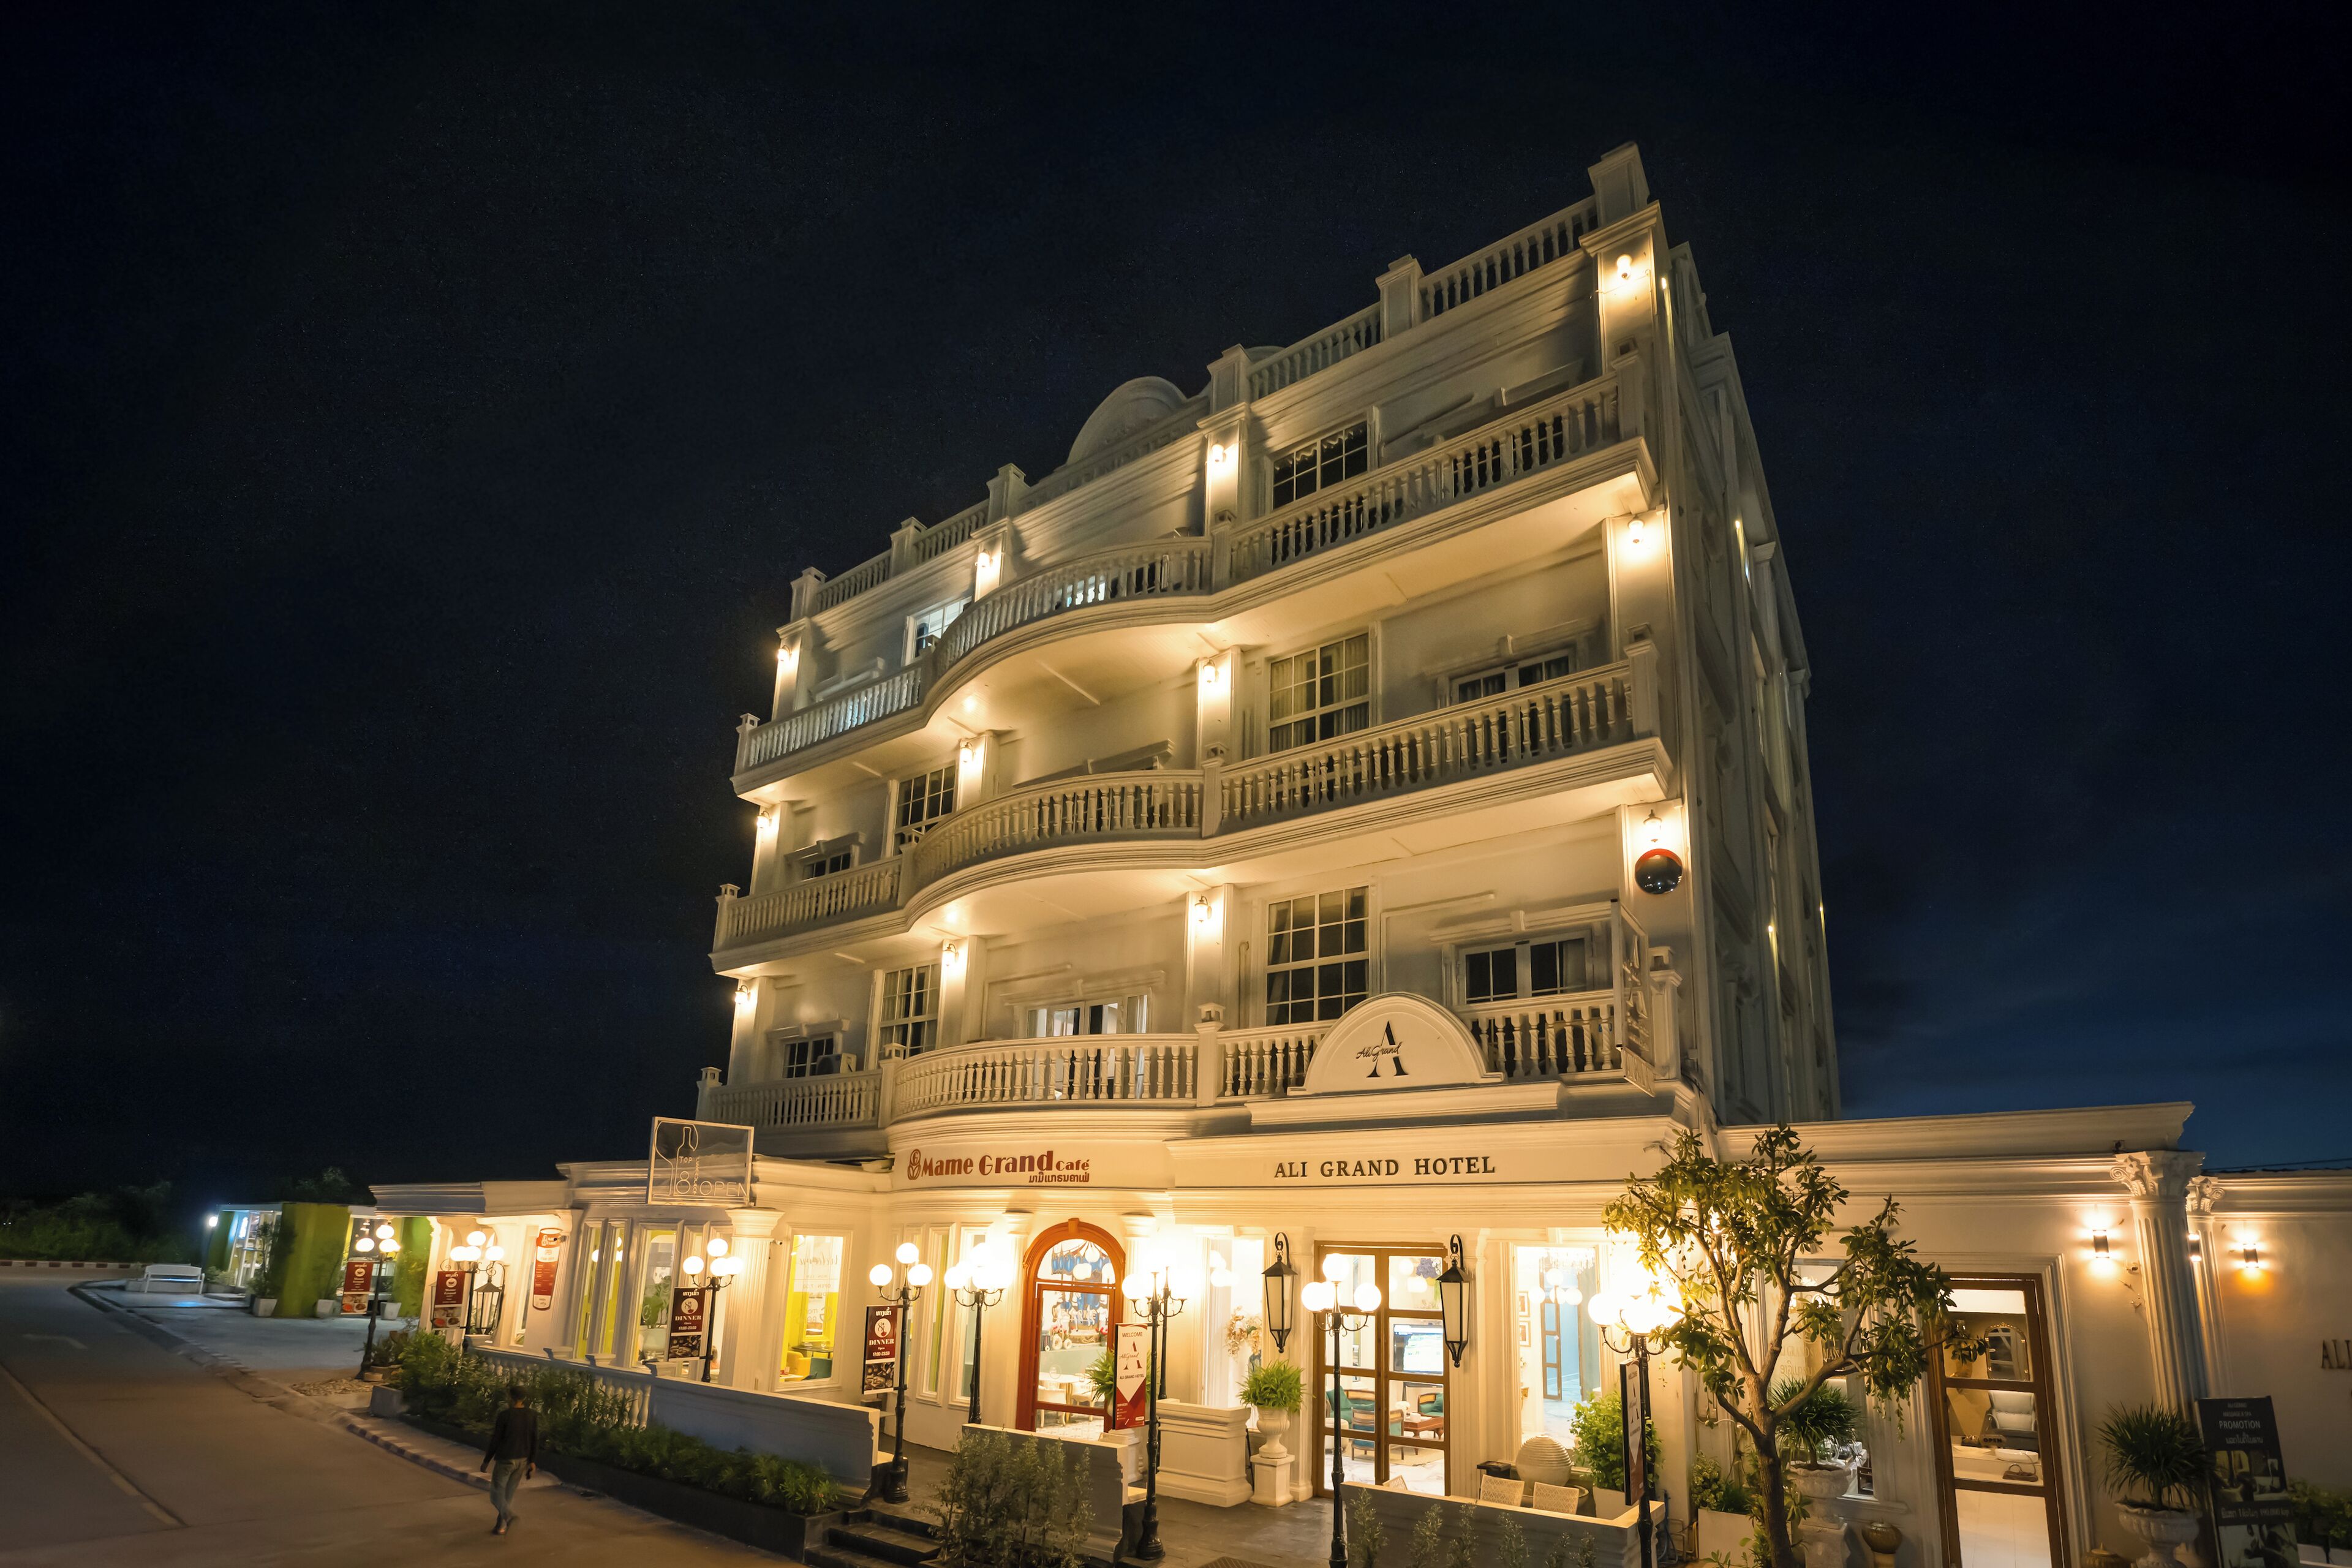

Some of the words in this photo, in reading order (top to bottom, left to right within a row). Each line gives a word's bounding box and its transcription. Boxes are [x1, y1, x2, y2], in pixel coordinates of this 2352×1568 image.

[921, 1157, 973, 1177] Mame
[979, 1150, 1054, 1175] Grand
[1274, 1161, 1308, 1178] ALI
[1320, 1159, 1399, 1177] GRAND
[1414, 1156, 1495, 1175] HOTEL
[699, 1180, 749, 1197] OPEN
[2219, 1420, 2261, 1429] PROMOTION
